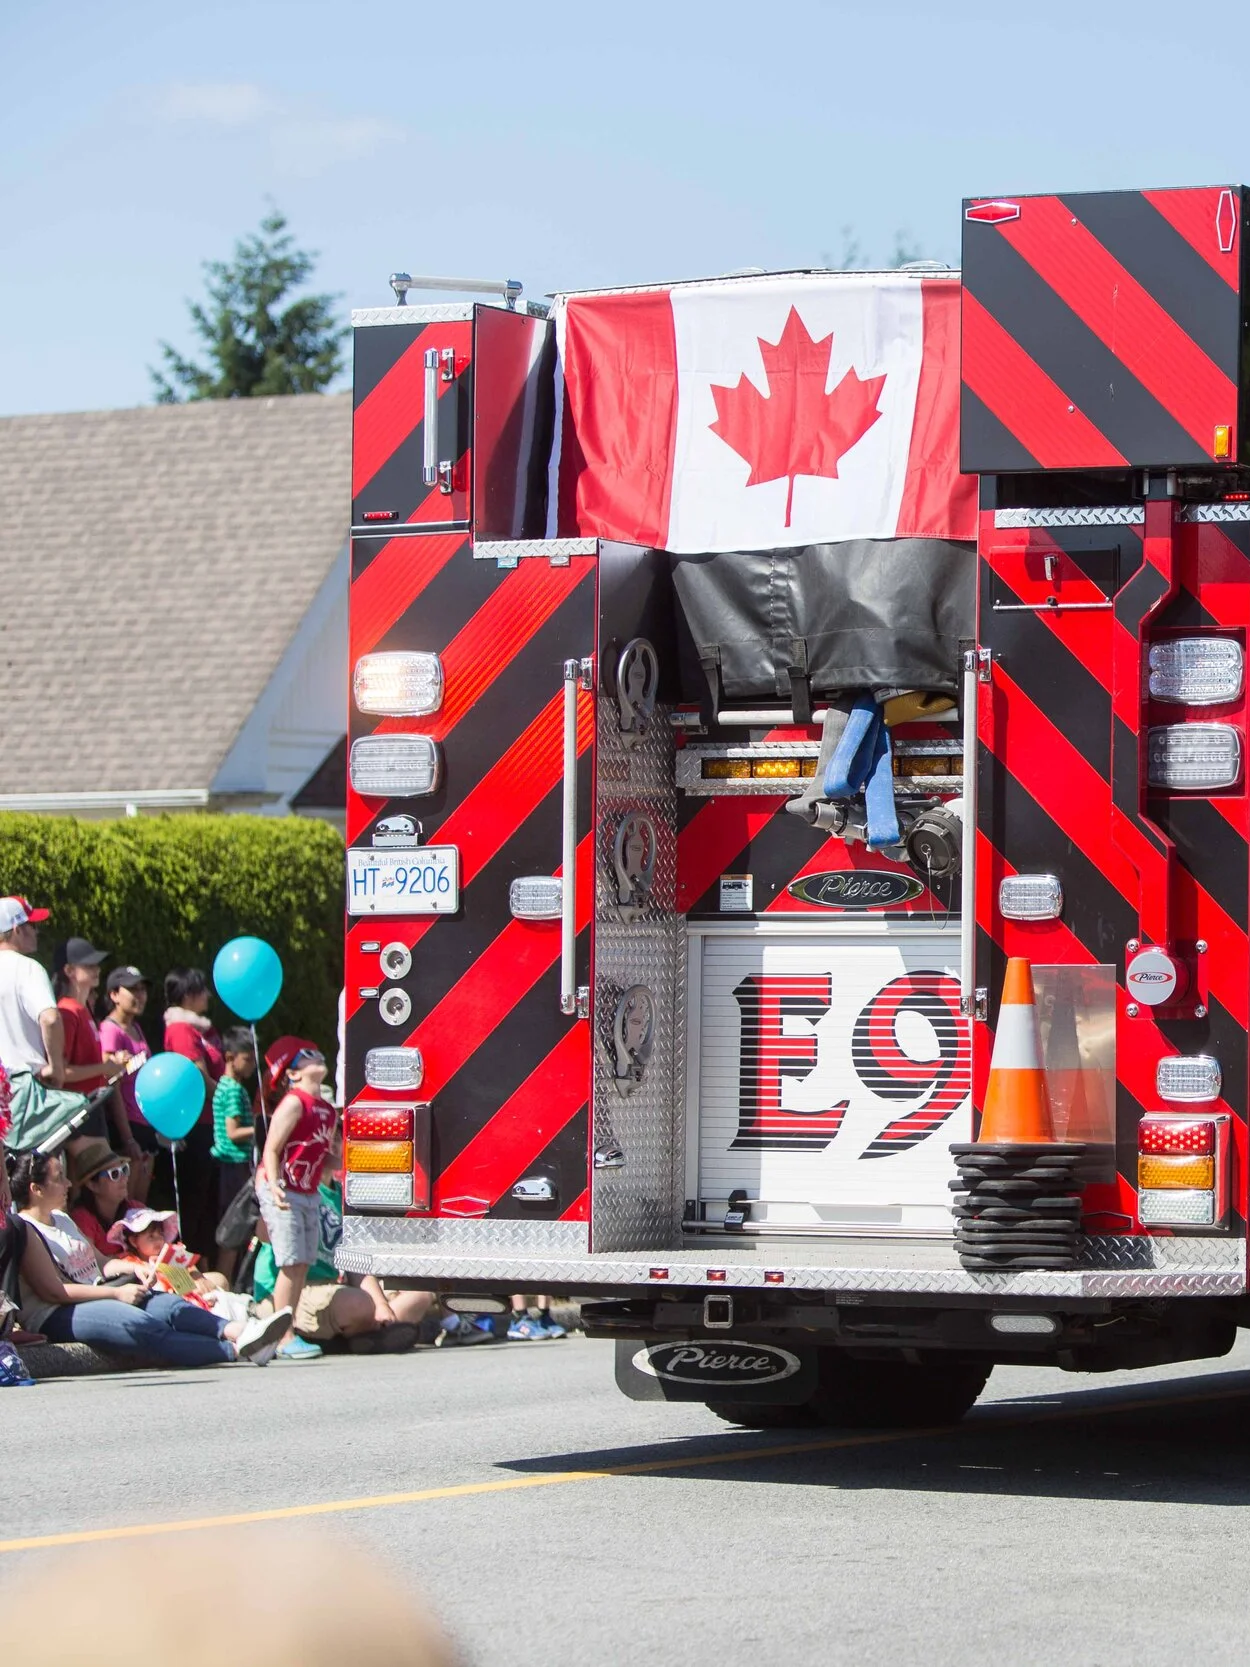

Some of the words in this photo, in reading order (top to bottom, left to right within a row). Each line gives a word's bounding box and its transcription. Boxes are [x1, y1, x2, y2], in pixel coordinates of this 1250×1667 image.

[353, 867, 380, 896] HT
[395, 866, 450, 895] 9206
[817, 875, 893, 901] Pierce
[1138, 973, 1163, 982] Pierce
[727, 970, 972, 1160] E9
[666, 1347, 771, 1372] Pierce
